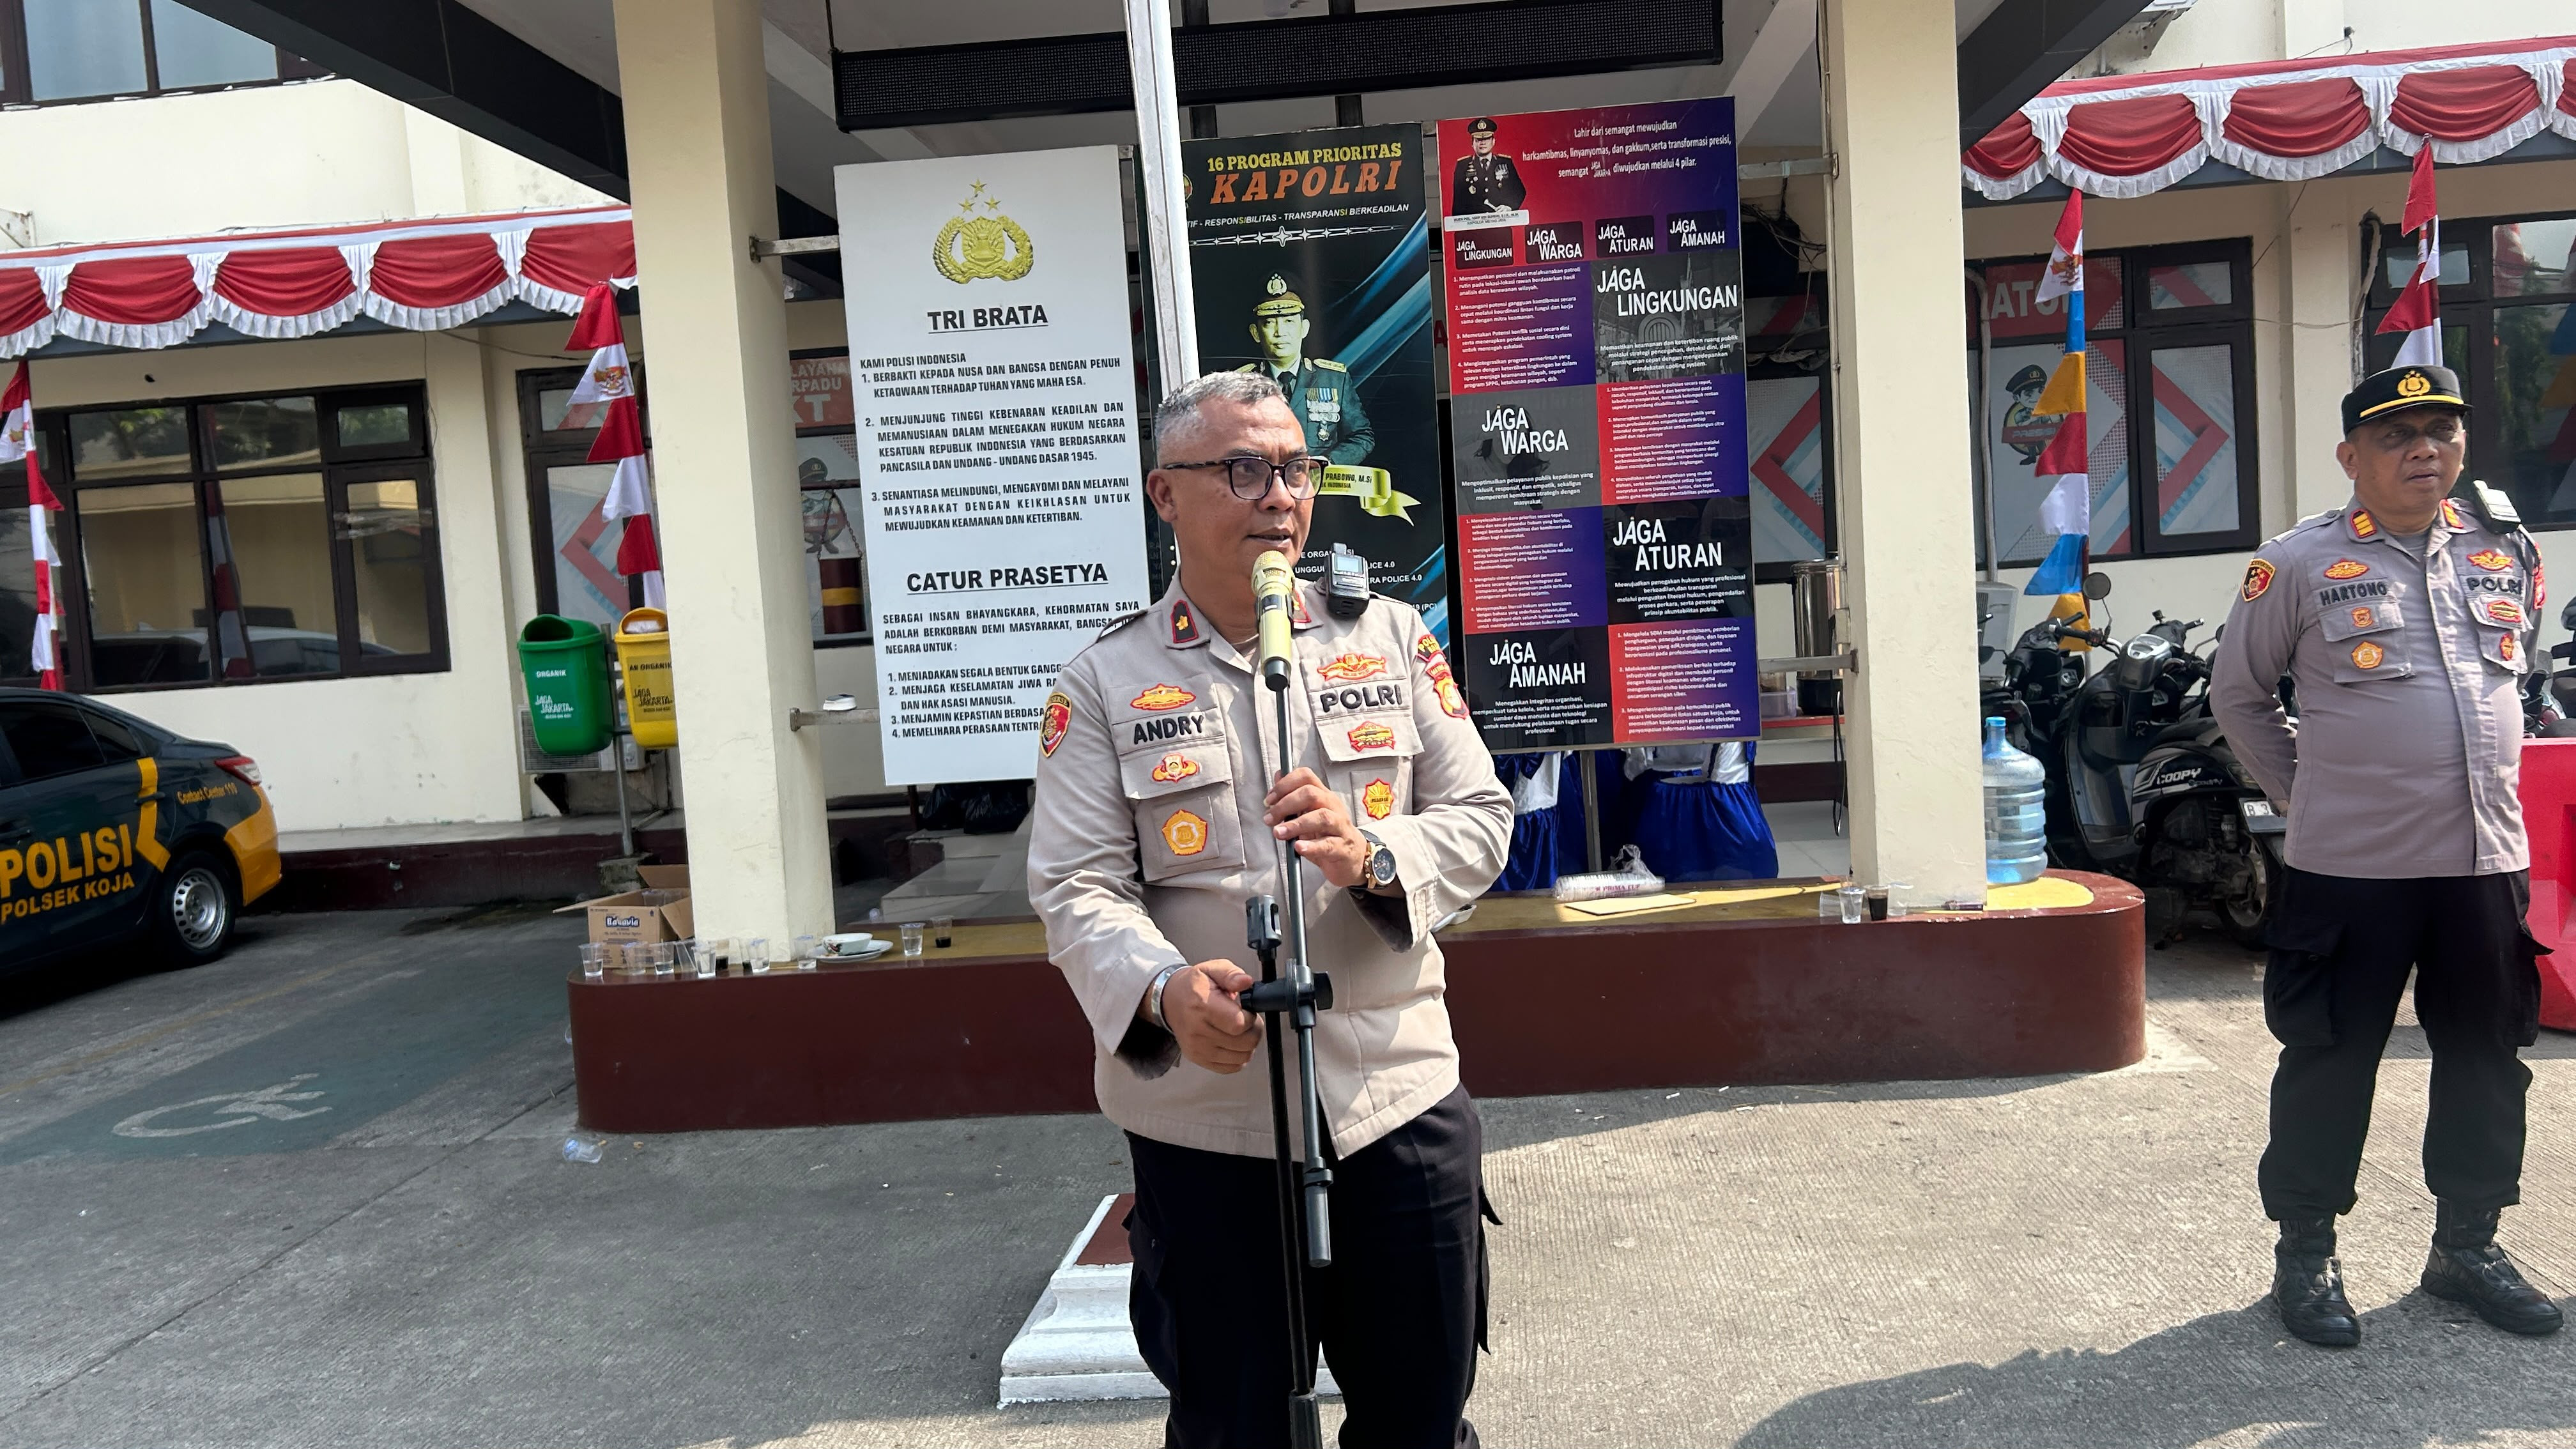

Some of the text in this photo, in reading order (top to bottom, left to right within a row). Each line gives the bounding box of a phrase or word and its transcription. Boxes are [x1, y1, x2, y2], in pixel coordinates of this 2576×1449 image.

[1574, 120, 1677, 138] Lahir dari semangat mewujudkan
[1208, 142, 1401, 172] 16 PROGRAM PRIORITAS
[1558, 166, 1589, 178] semangat
[1613, 161, 1650, 174] diwujudkan
[1650, 158, 1675, 170] melalui
[1210, 160, 1402, 204] KAPOLRI
[1204, 214, 1276, 227] RESPONSIBILITAS
[1284, 208, 1347, 220] TRANSPARANSI
[1349, 204, 1409, 216] BERKEADILAN
[1670, 220, 1696, 234] JAGA
[1527, 230, 1557, 245] JAGA
[1598, 224, 1625, 240] JAGA
[1681, 231, 1724, 247] AMANAH
[1457, 240, 1476, 252] JAGA
[1464, 247, 1512, 261] LINGKUNGAN
[1540, 243, 1582, 260] WARGA
[1609, 237, 1653, 253] ATURAN
[1597, 268, 1645, 292] JAGA
[1617, 285, 1738, 316] LINGKUNGAN
[927, 305, 1049, 330] TRI BRATA
[860, 353, 966, 369] KAMI POLISI INDONESIA
[861, 357, 1120, 383] 1. BERBAKTI KEPADA NUSA DAN BANGSA DENGAN PENUH
[874, 376, 1086, 398] KETAQWAAN TERHADAP TUHAN YANG MAHA ESA.
[865, 402, 1124, 427] 2. MENJUNJUNG TINGGI KEBENARAN KEADILAN DAN
[1482, 407, 1529, 432] JAGA
[1501, 429, 1568, 455] WARGA
[1326, 473, 1357, 482] PRABOWO,
[871, 477, 1129, 502] 3. SENANTIASA MELINDUNGI, MENGAYOMI DAN MELAYANI
[884, 493, 1130, 516] MASYARAKAT DENGAN KEIKHLASAN UNTUK
[885, 511, 1082, 532] MEWUJUDKAN KEAMANAN DAN KETERTIBAN.
[1613, 518, 1666, 546] JAGA
[1636, 542, 1722, 571] ATURAN
[907, 563, 1108, 592] CATUR PRASETYA
[2319, 581, 2388, 606] HARTONO
[883, 601, 1140, 624] SEBAGAI INSAN BHAYANGKARA, KEHORMATAN SAYA
[1422, 603, 1438, 611] (PC)
[884, 628, 919, 640] ADALAH
[923, 625, 977, 637] BERKORBAN
[982, 624, 1005, 634] DEMI
[1009, 620, 1072, 632] MASYARAKAT,
[1076, 617, 1117, 630] BANGS,
[885, 643, 921, 654] NEGARA
[923, 641, 953, 652] UNTUK
[1490, 640, 1536, 665] JAGA
[536, 670, 567, 678] ORGANIK
[888, 673, 896, 682] 1.
[898, 669, 958, 682] MENIADAKAN
[960, 667, 993, 678] SEGALA
[995, 665, 1030, 676] BENTUK
[1510, 663, 1586, 688] AMANAH
[889, 686, 898, 696] 2.
[901, 684, 946, 695] MENJAGA
[950, 680, 1013, 693] KESELAMATAN
[1018, 678, 1042, 689] JIWA
[1320, 684, 1402, 713] POLRI
[901, 695, 1016, 710] DAN HAK ASASI MANUSIA.
[1133, 714, 1204, 745] ANDRY
[176, 791, 204, 805] Contact
[204, 786, 226, 801] Center
[2247, 804, 2255, 816] B
[0, 823, 133, 898] POLISI
[1, 871, 134, 925] POLSEK KOJA
